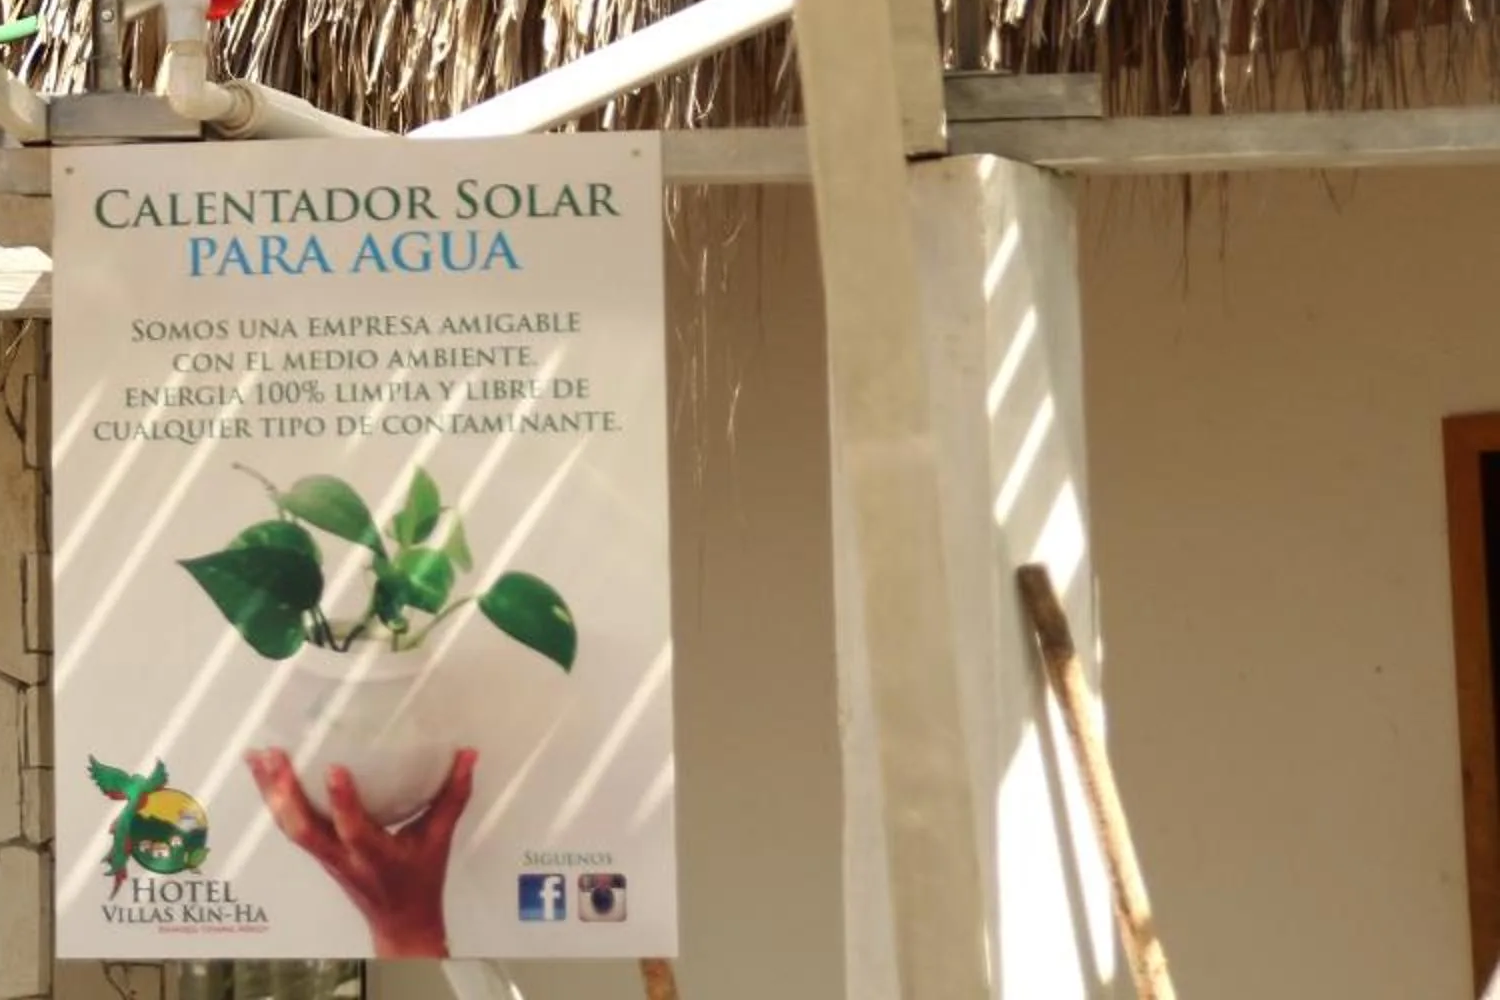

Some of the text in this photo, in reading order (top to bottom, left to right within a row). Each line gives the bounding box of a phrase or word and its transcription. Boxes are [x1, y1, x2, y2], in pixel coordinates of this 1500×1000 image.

[94, 179, 621, 229] CALENTADOR SOLAR
[187, 229, 523, 278] PARA AGUA
[131, 311, 581, 342] SOMOS UNA EMPRESA AMIGABLE
[172, 345, 537, 374] CON EL MEDIO AMBIENTE.
[255, 379, 325, 405] 100%
[336, 380, 430, 403] LIMPIA
[438, 380, 455, 401] Y
[466, 379, 541, 401] LIBRE
[552, 377, 590, 399] DE
[93, 410, 622, 446] CUALQUIER TIPO DE CONTAMINANTE.
[132, 877, 238, 904] HOTEL
[101, 903, 268, 924] VILLAS KIN-HA
